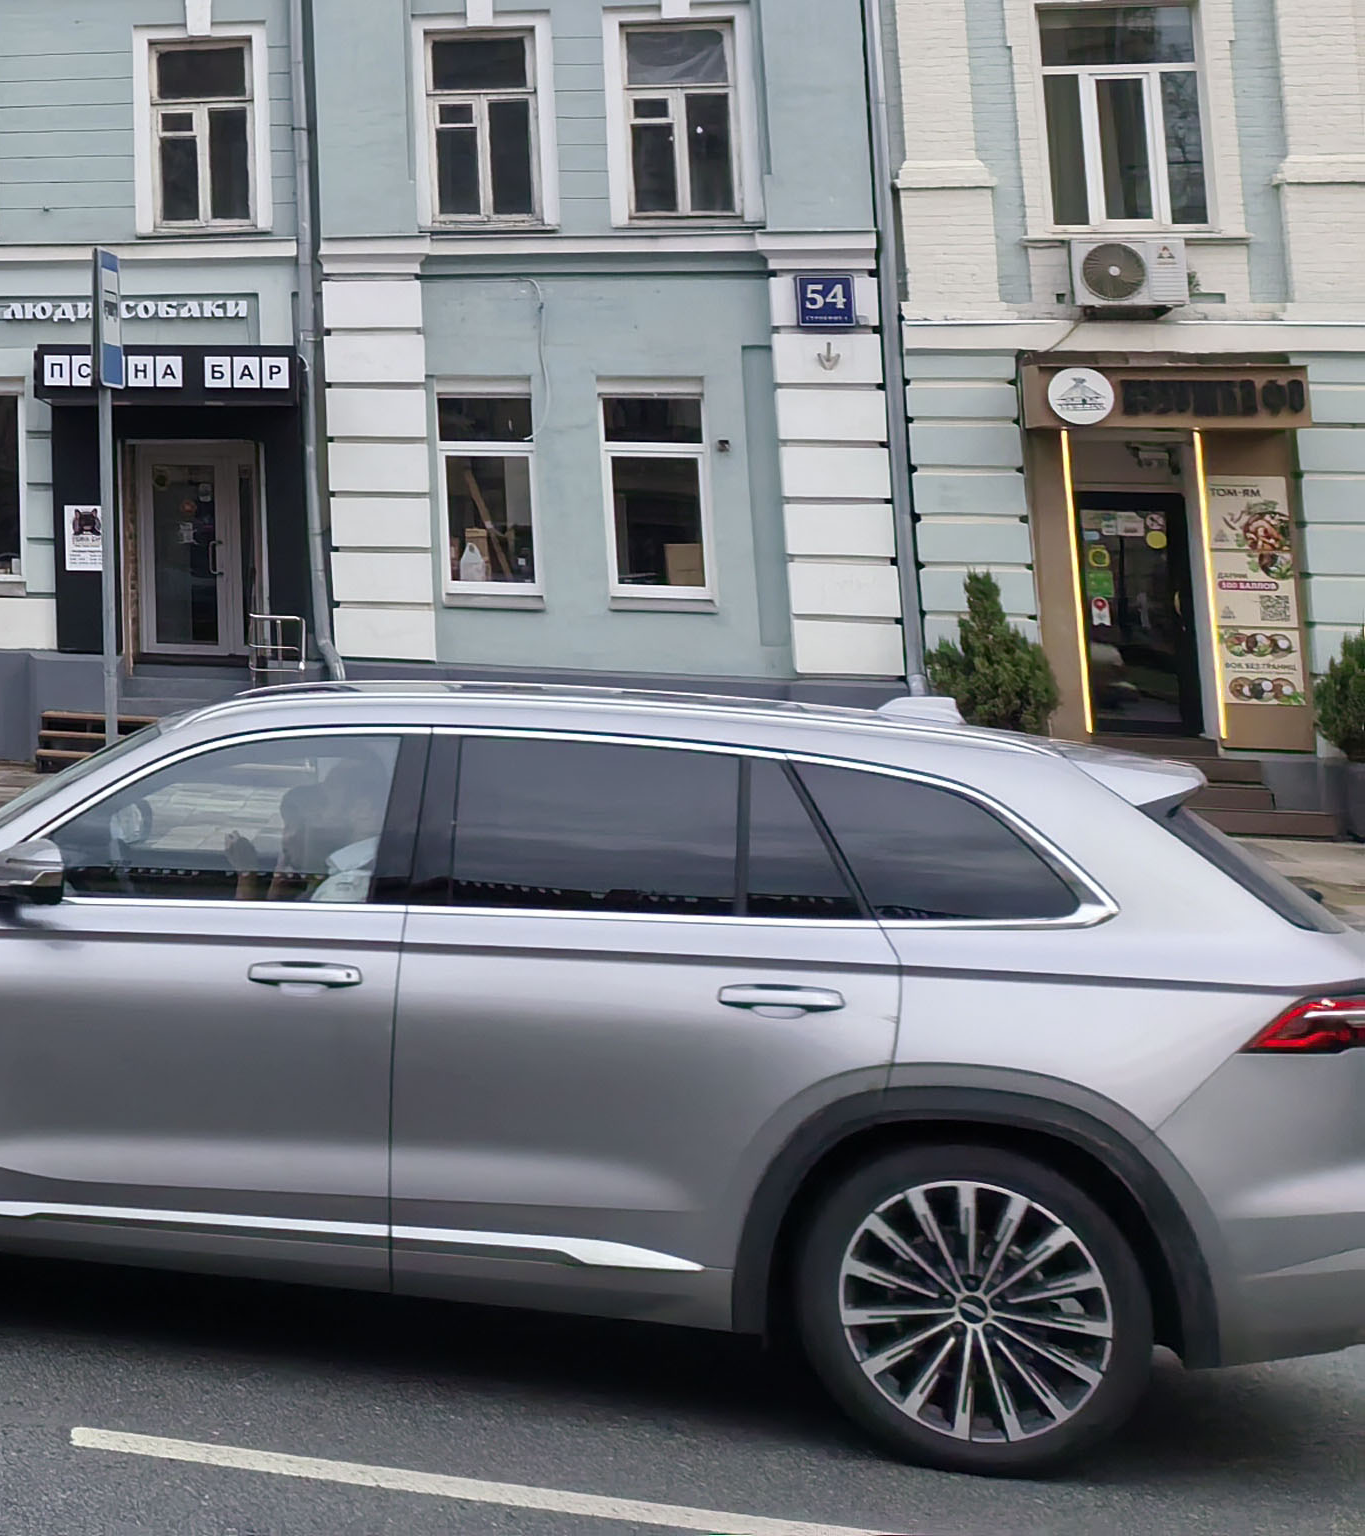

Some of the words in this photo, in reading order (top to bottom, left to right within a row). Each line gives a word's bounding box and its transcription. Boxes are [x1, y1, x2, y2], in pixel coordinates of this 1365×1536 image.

[805, 284, 847, 309] 54
[120, 300, 248, 318] СОБАКИ
[50, 362, 177, 380] ПСНА
[211, 363, 282, 381] БАР
[1209, 488, 1261, 498] ТОМ-ЯМ
